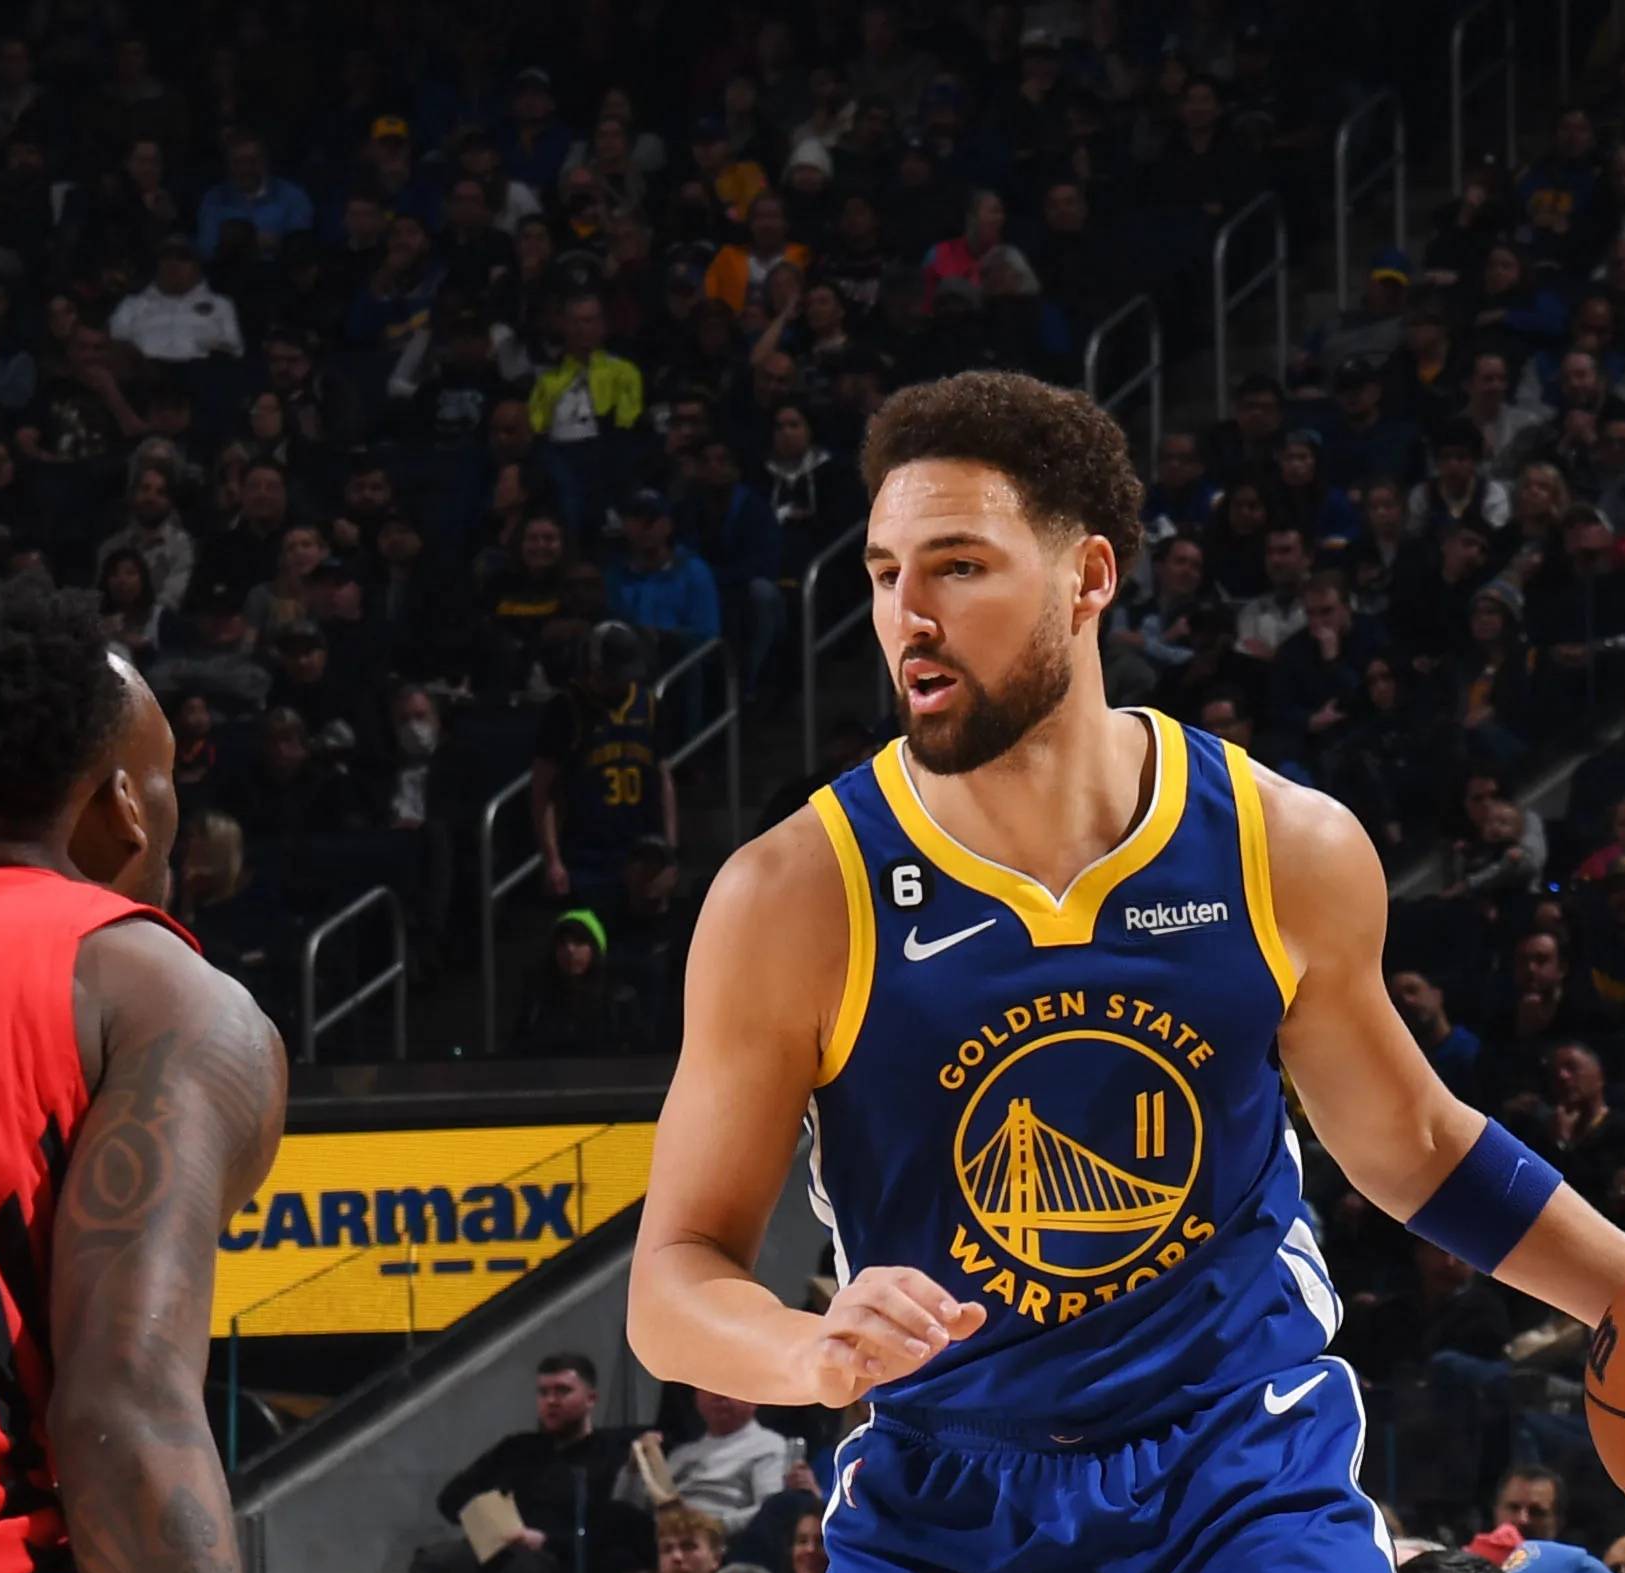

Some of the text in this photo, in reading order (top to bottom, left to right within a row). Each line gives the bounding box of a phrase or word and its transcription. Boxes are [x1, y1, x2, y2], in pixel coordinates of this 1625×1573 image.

[602, 766, 642, 805] 30
[892, 864, 924, 907] 6
[1125, 900, 1228, 931] Rakuten
[938, 990, 1215, 1090] GOLDEN STATE
[1135, 1089, 1166, 1159] 11
